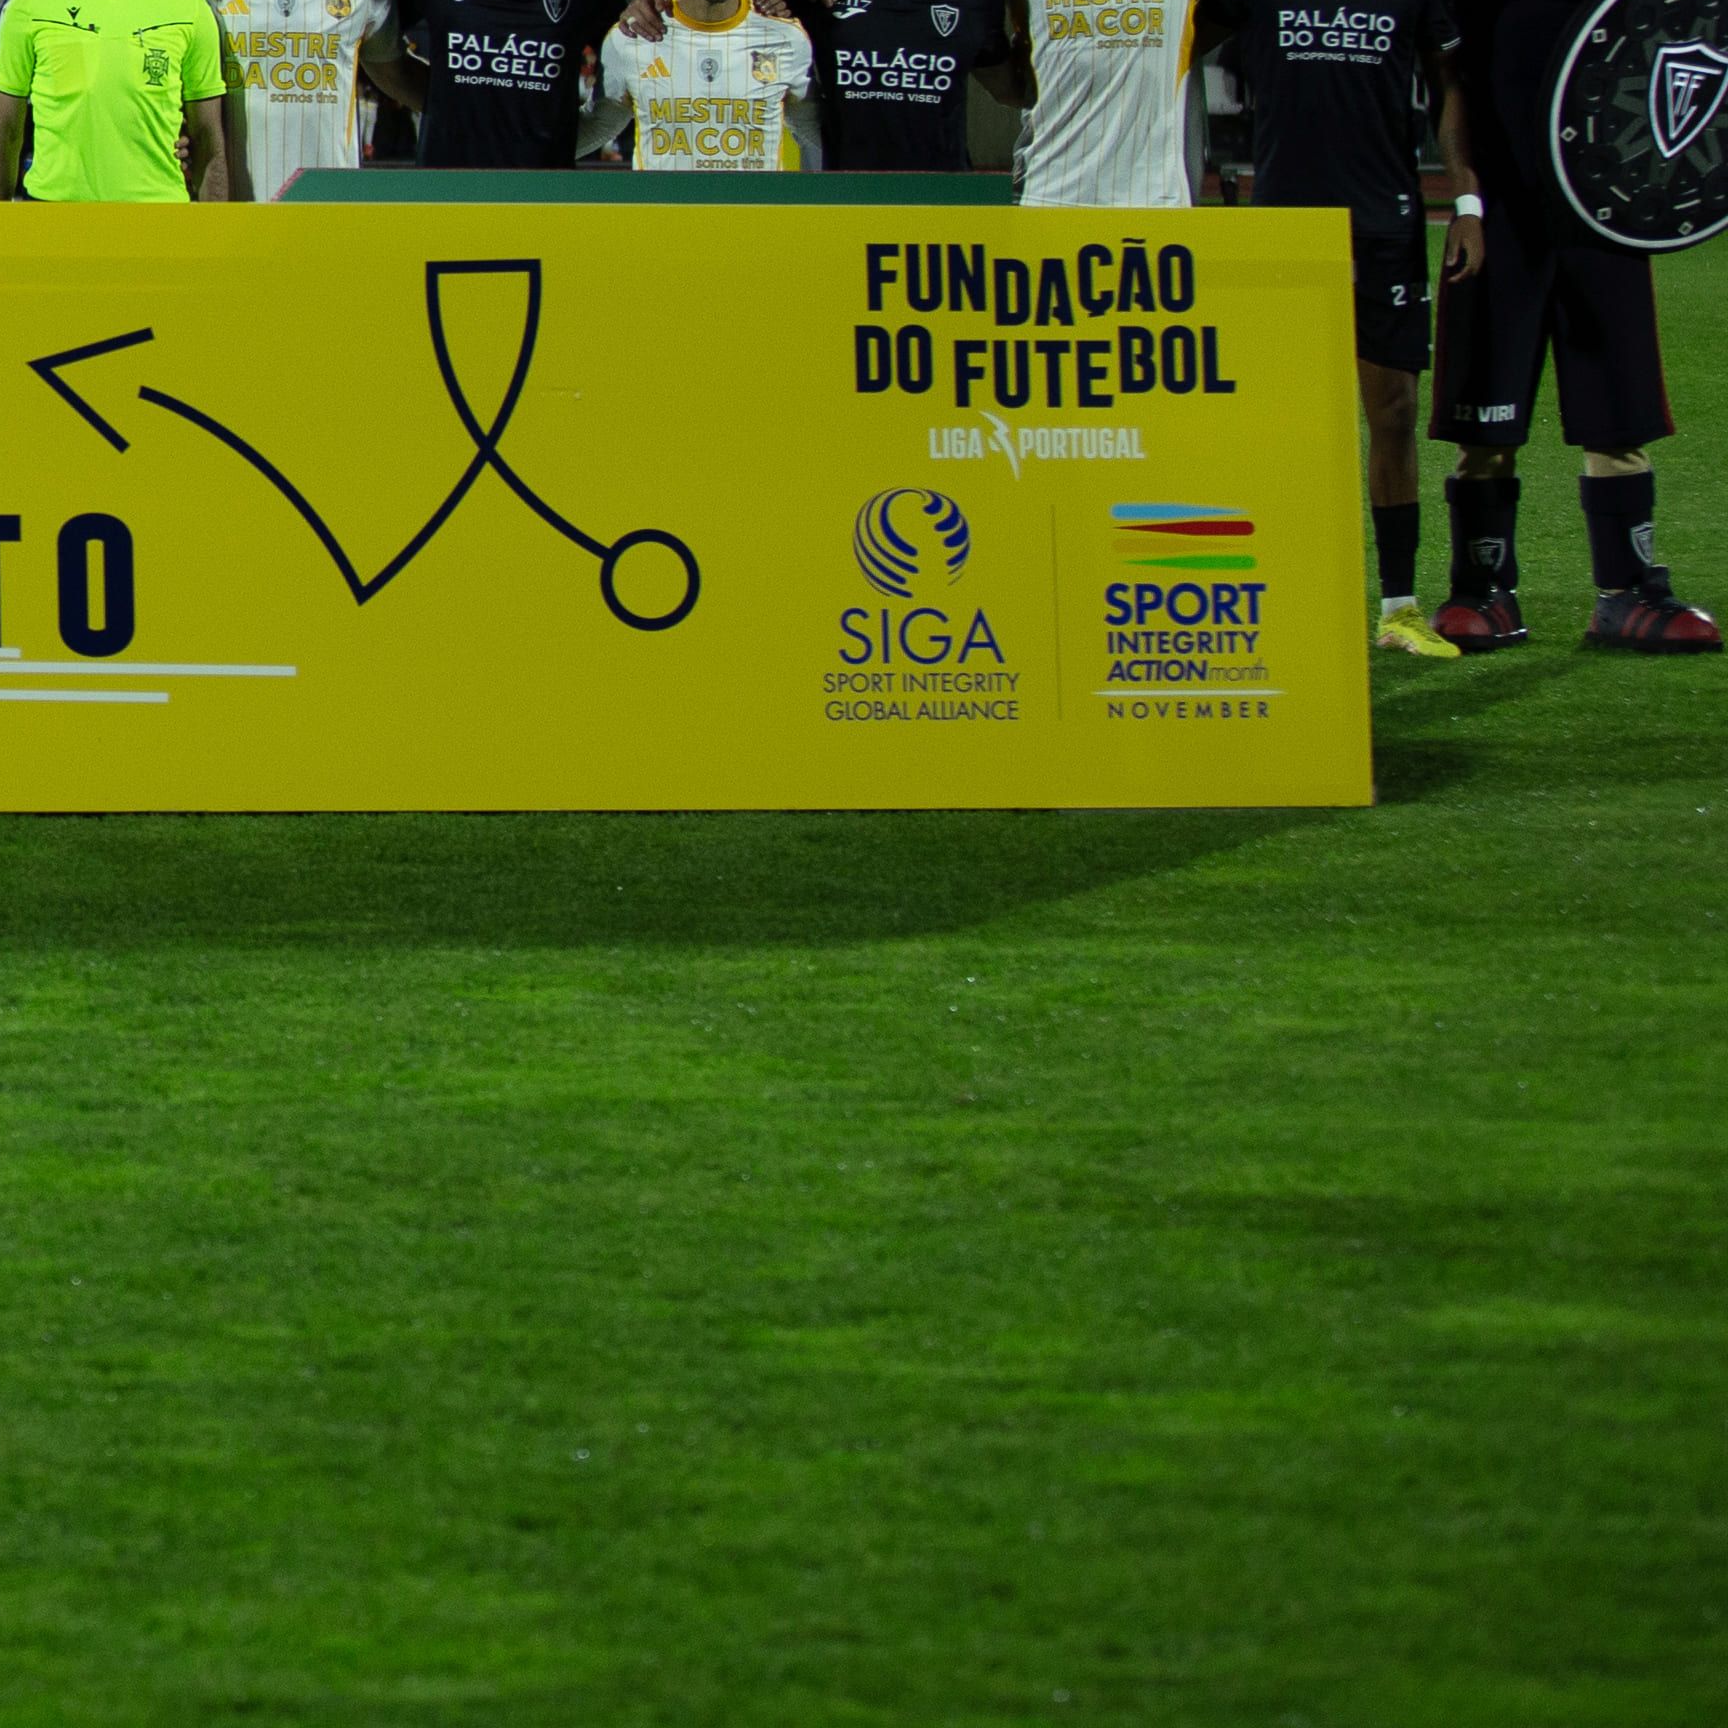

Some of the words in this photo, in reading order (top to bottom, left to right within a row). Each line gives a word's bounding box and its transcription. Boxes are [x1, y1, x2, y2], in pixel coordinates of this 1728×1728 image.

[1047, 10, 1093, 41] DA
[1095, 7, 1164, 37] COR
[1277, 5, 1397, 33] PALÁCIO
[224, 32, 342, 59] MESTRE
[447, 32, 566, 60] PALÁCIO
[1278, 30, 1314, 48] DO
[1321, 30, 1392, 53] GELO
[447, 51, 482, 71] DO
[490, 56, 562, 79] GELO
[834, 47, 957, 72] PALÁCIO
[224, 60, 267, 89] DA
[270, 61, 338, 91] COR
[453, 74, 514, 88] SHOPPING
[516, 80, 552, 93] VISEU
[836, 68, 872, 86] DO
[880, 71, 952, 92] GELO
[844, 90, 904, 102] SHOPPING
[648, 97, 768, 125] MESTRE
[651, 127, 693, 157] DA
[695, 127, 765, 157] COR
[866, 237, 1195, 326] FUNDAÇÃO
[854, 324, 933, 394] DO
[953, 324, 1236, 409] FUTEBOL
[928, 426, 985, 460] LIGA
[1018, 427, 1148, 461] PORTUGAL
[1104, 582, 1267, 625] SPORT
[839, 607, 1005, 664] SIGA
[1107, 630, 1260, 655] INTEGRITY
[823, 672, 896, 693] SPORT
[902, 672, 1020, 693] INTEGRITY
[825, 699, 912, 721] GLOBAL
[916, 699, 1020, 721] ALLIANCE
[1107, 702, 1270, 720] NOVEMBER
